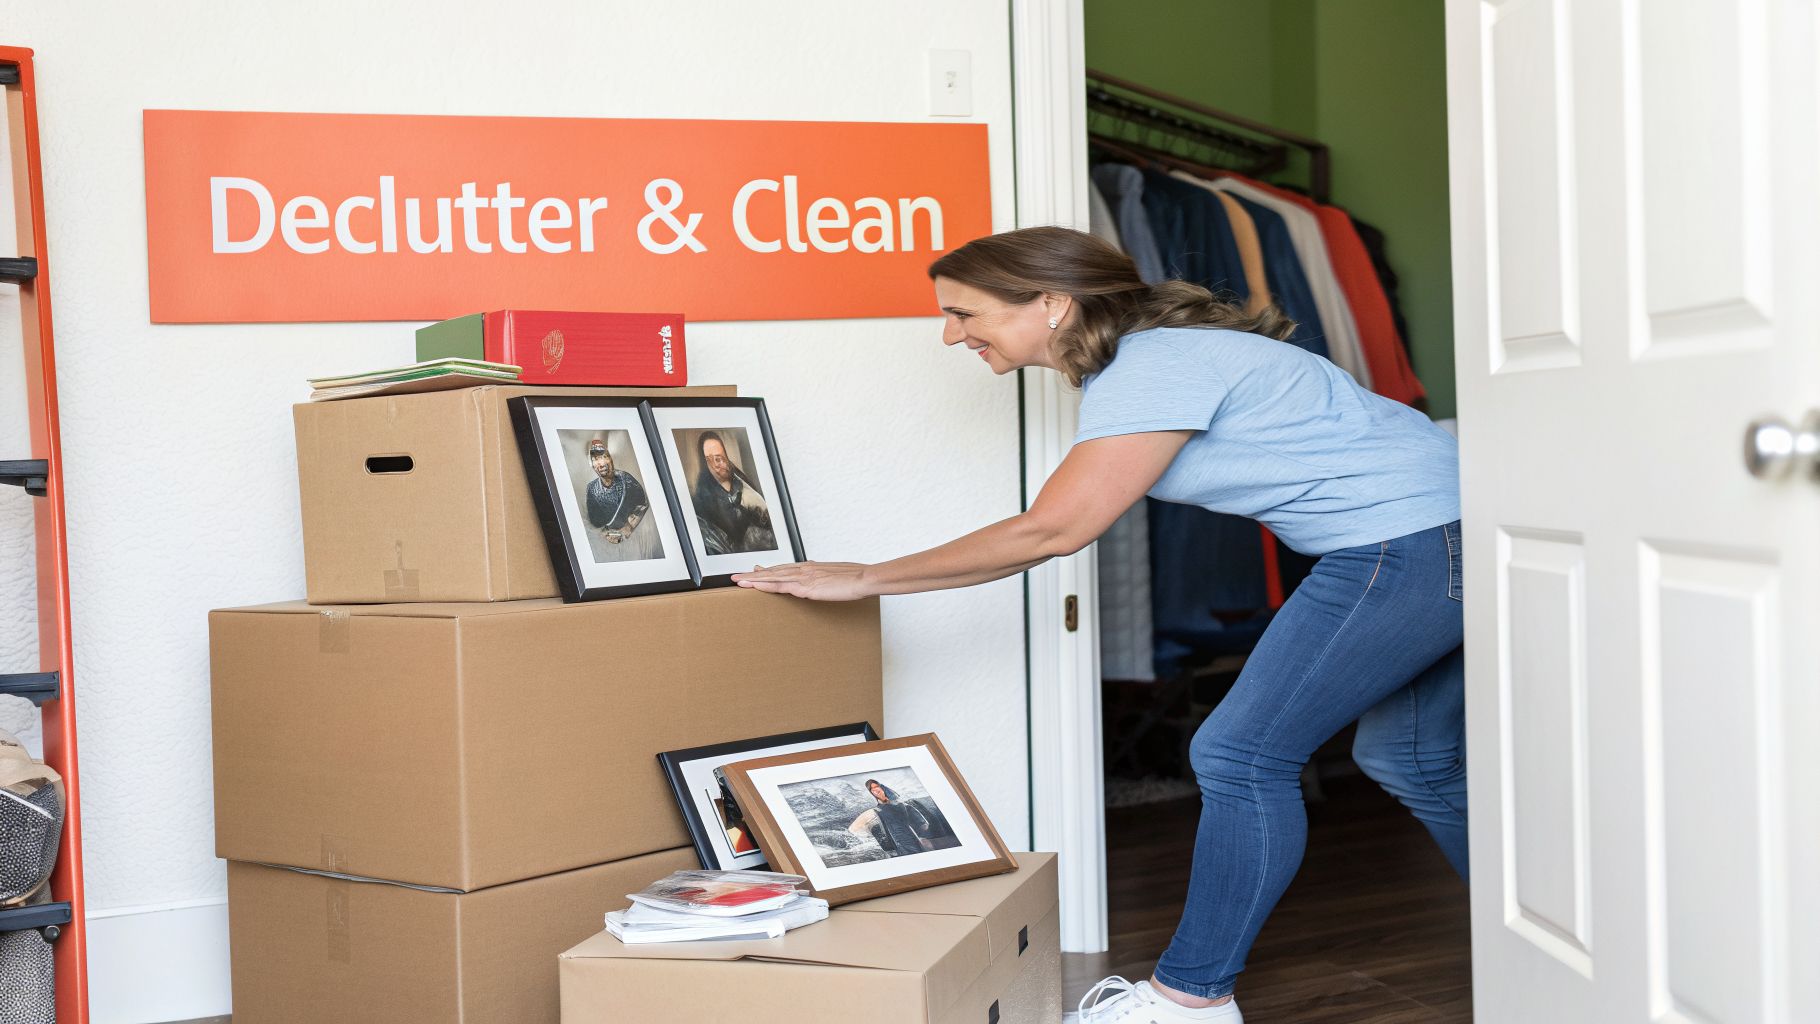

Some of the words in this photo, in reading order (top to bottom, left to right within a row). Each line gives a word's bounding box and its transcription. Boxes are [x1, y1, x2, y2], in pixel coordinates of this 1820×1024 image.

[210, 175, 608, 254] Declutter
[637, 178, 707, 254] &
[733, 176, 943, 254] Clean
